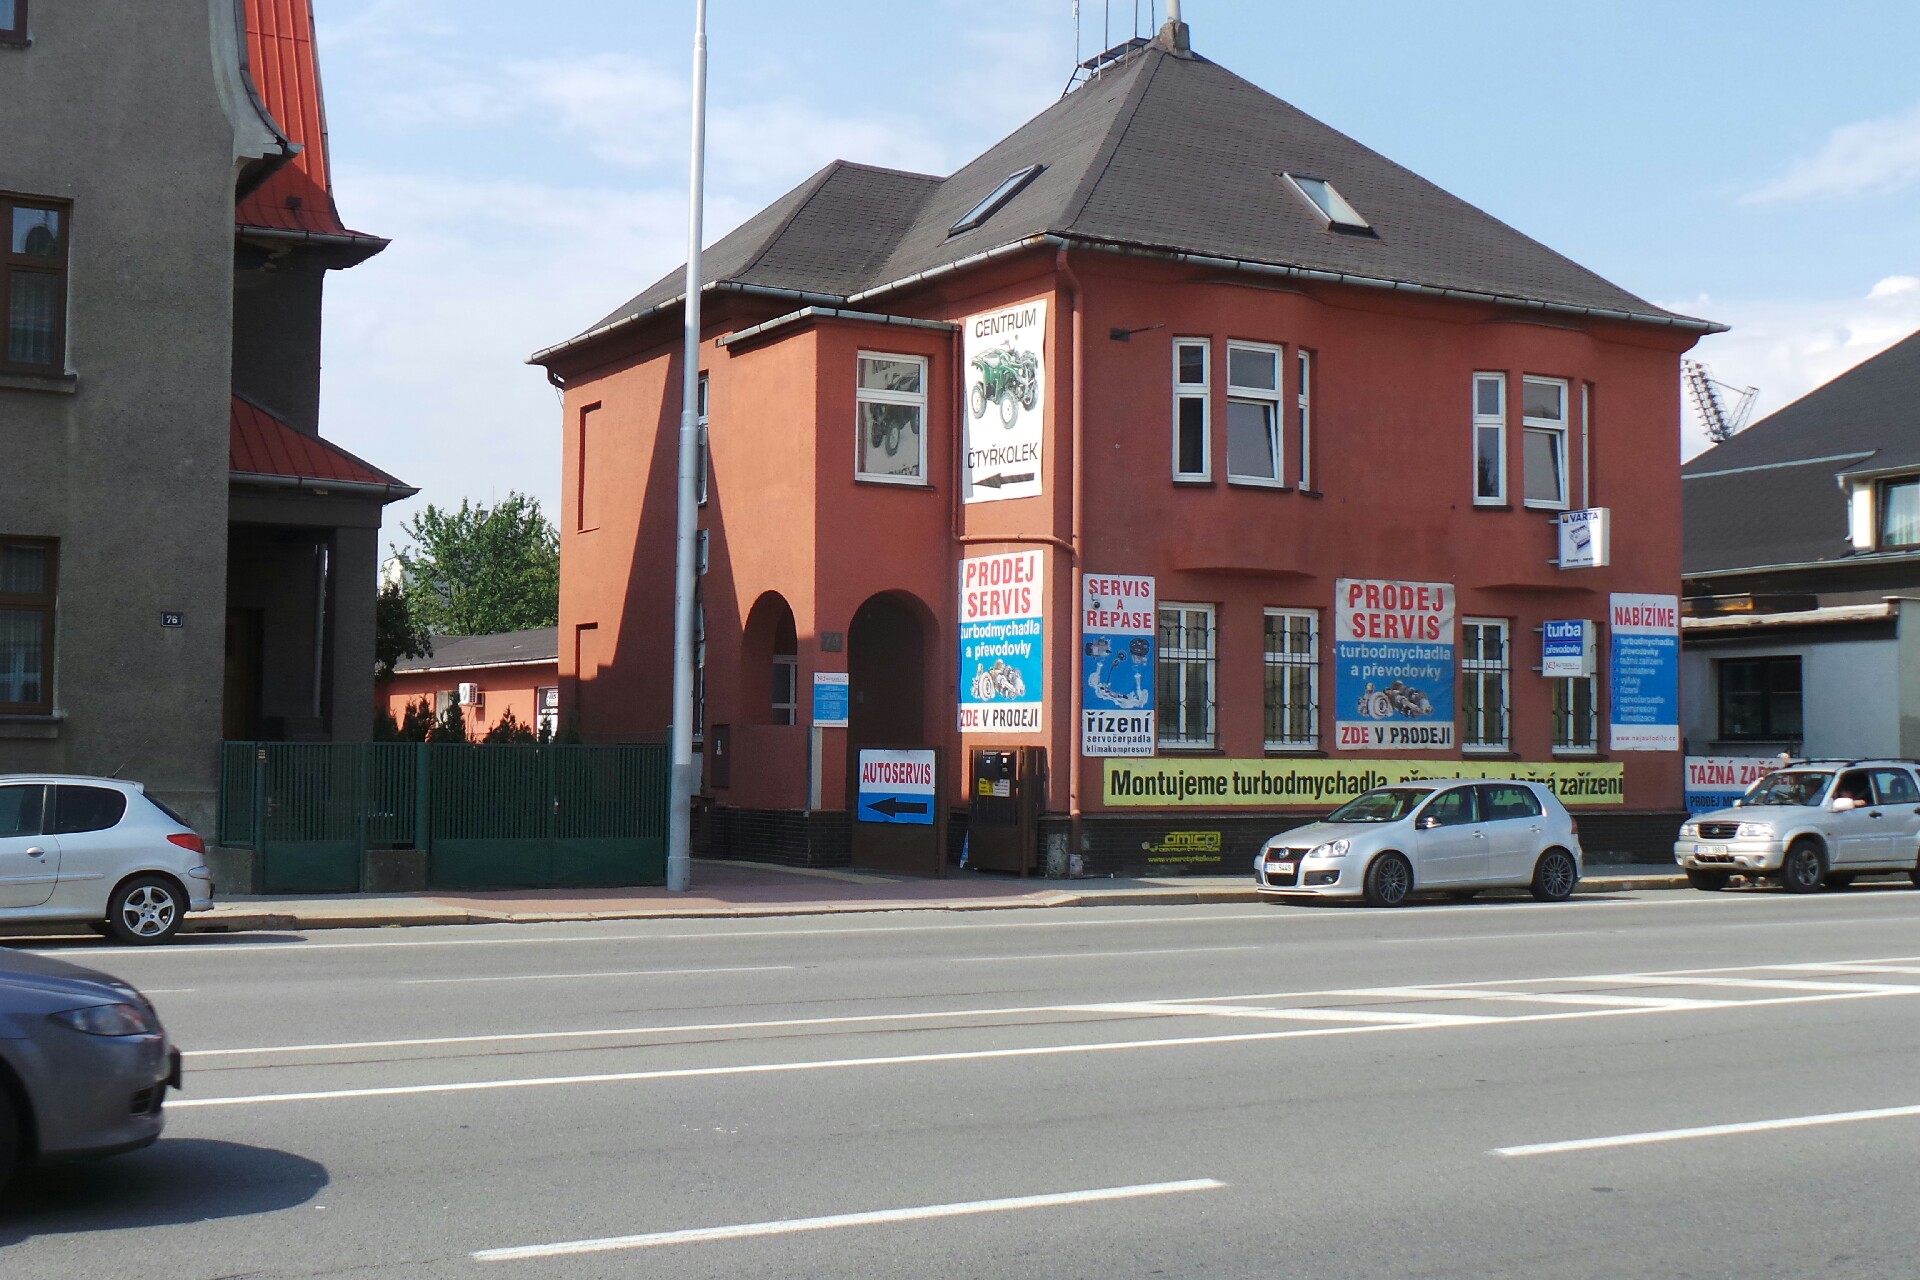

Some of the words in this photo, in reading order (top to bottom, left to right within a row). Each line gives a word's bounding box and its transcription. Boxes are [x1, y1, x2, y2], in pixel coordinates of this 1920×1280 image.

[975, 308, 1037, 338] CENTRUM
[967, 442, 1039, 469] ČTYŘKOLEK
[1569, 511, 1599, 523] VARTA
[965, 555, 1035, 588] PRODEJ
[1088, 578, 1150, 597] SERVIS
[967, 587, 1031, 618] SERVIS
[1116, 599, 1124, 610] A
[1349, 583, 1444, 612] PRODEJ
[166, 615, 178, 624] 76
[1086, 610, 1152, 628] REPASE
[1615, 602, 1675, 627] NABÍZÍME
[1352, 612, 1440, 640] SERVIS
[1547, 623, 1582, 638] turba
[965, 645, 972, 658] a
[974, 640, 1032, 660] převodovky
[1340, 644, 1450, 662] turbodmychadla
[1545, 644, 1581, 655] převodovky
[1351, 665, 1359, 676] a
[1363, 662, 1441, 681] převodovky
[960, 709, 979, 727] ZDE
[982, 709, 990, 727] V
[992, 708, 1038, 727] PRODEJI
[1086, 711, 1151, 733] řízení
[1086, 733, 1151, 744] servočerpadla
[1341, 726, 1369, 744] ZDE
[1374, 727, 1384, 744] V
[1390, 727, 1450, 744] PRODEJI
[1086, 745, 1152, 755] klimakompresory
[862, 762, 931, 785] AUTOSERVIS
[1689, 760, 1736, 785] TAŽNÁ
[1111, 770, 1228, 800] Montujeme
[1560, 772, 1624, 796] zařízení
[1690, 795, 1720, 808] PRODEJ
